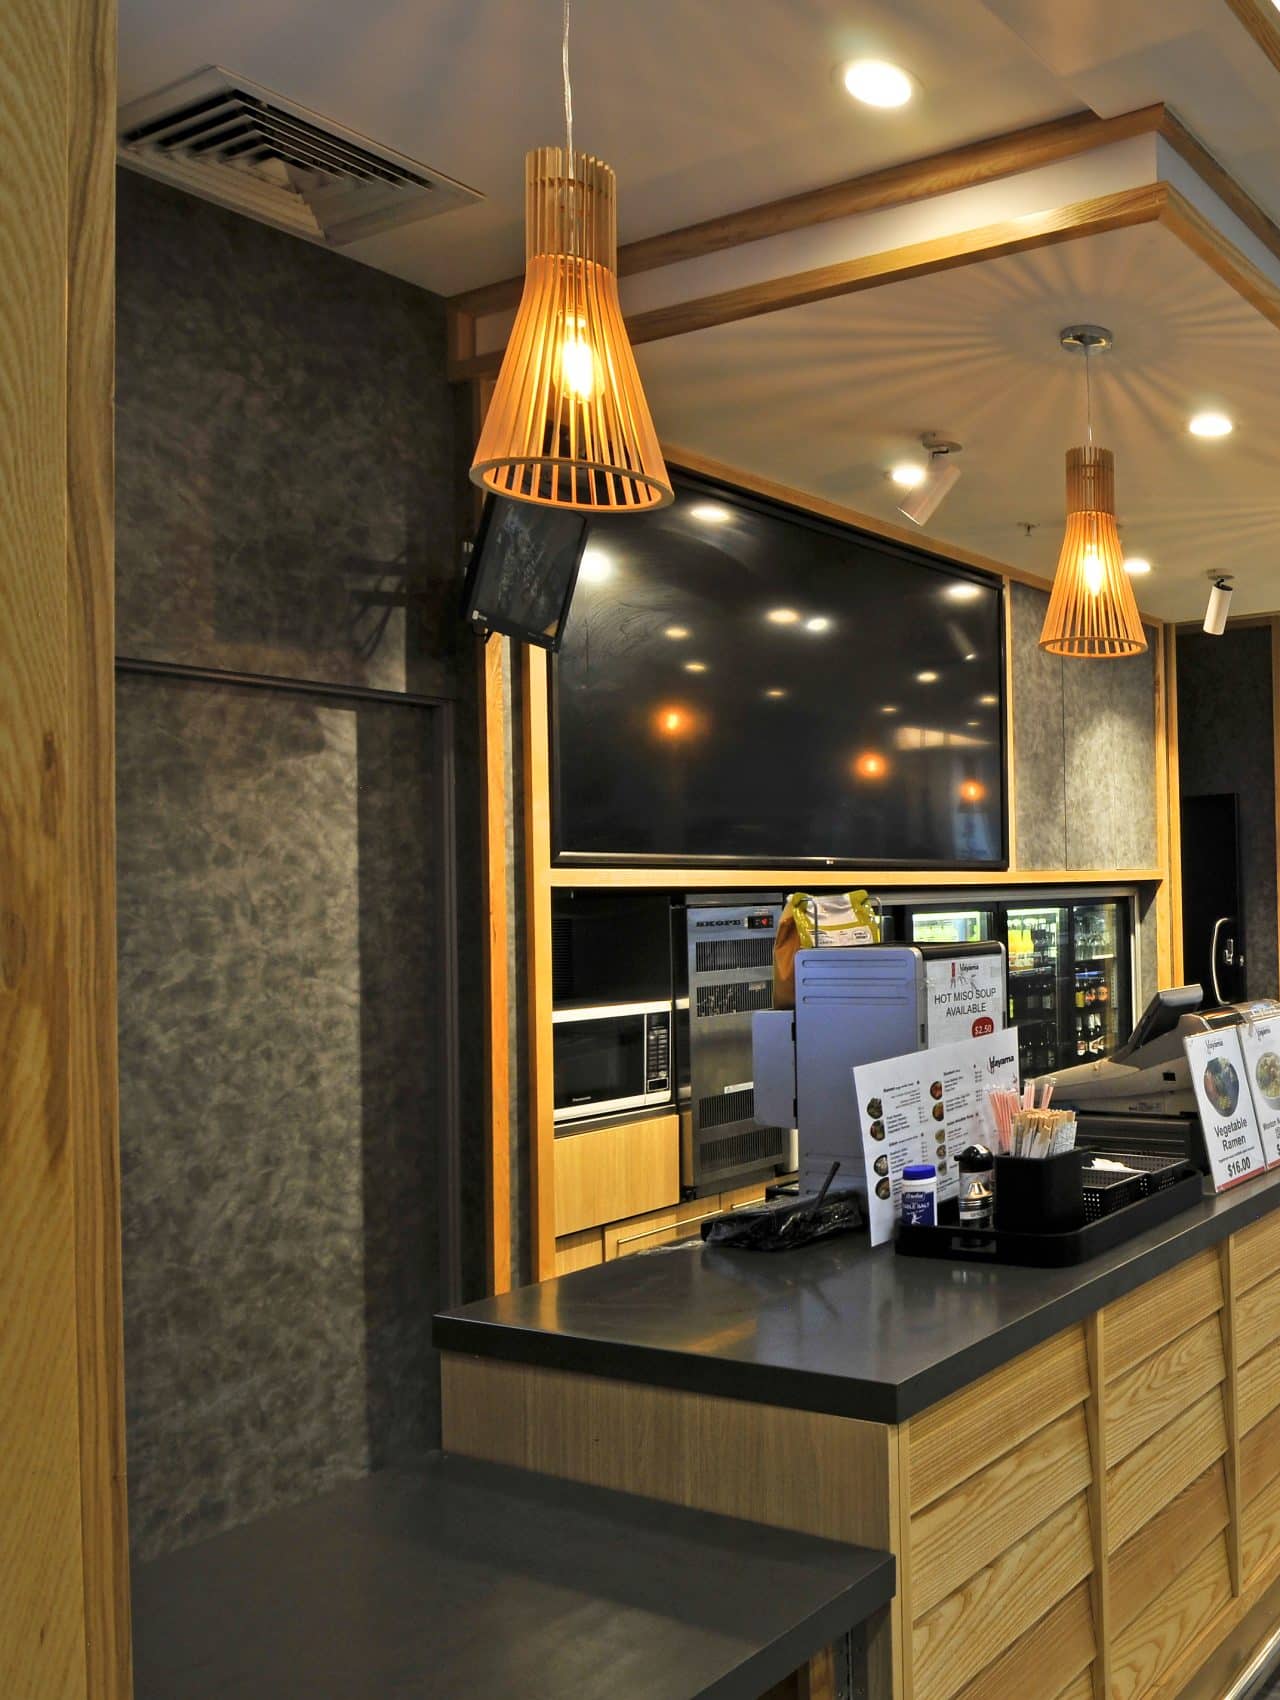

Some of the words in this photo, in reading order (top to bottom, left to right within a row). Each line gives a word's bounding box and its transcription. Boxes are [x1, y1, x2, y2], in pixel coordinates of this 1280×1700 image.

[934, 993, 952, 1005] HOT
[953, 990, 973, 1002] MISO
[975, 987, 996, 999] SOUP
[946, 1002, 987, 1018] AVAILABLE
[974, 1024, 992, 1035] $2.50
[1214, 1117, 1248, 1138] Vegetable
[1222, 1135, 1247, 1151] Ramen
[1227, 1156, 1251, 1178] $16.00
